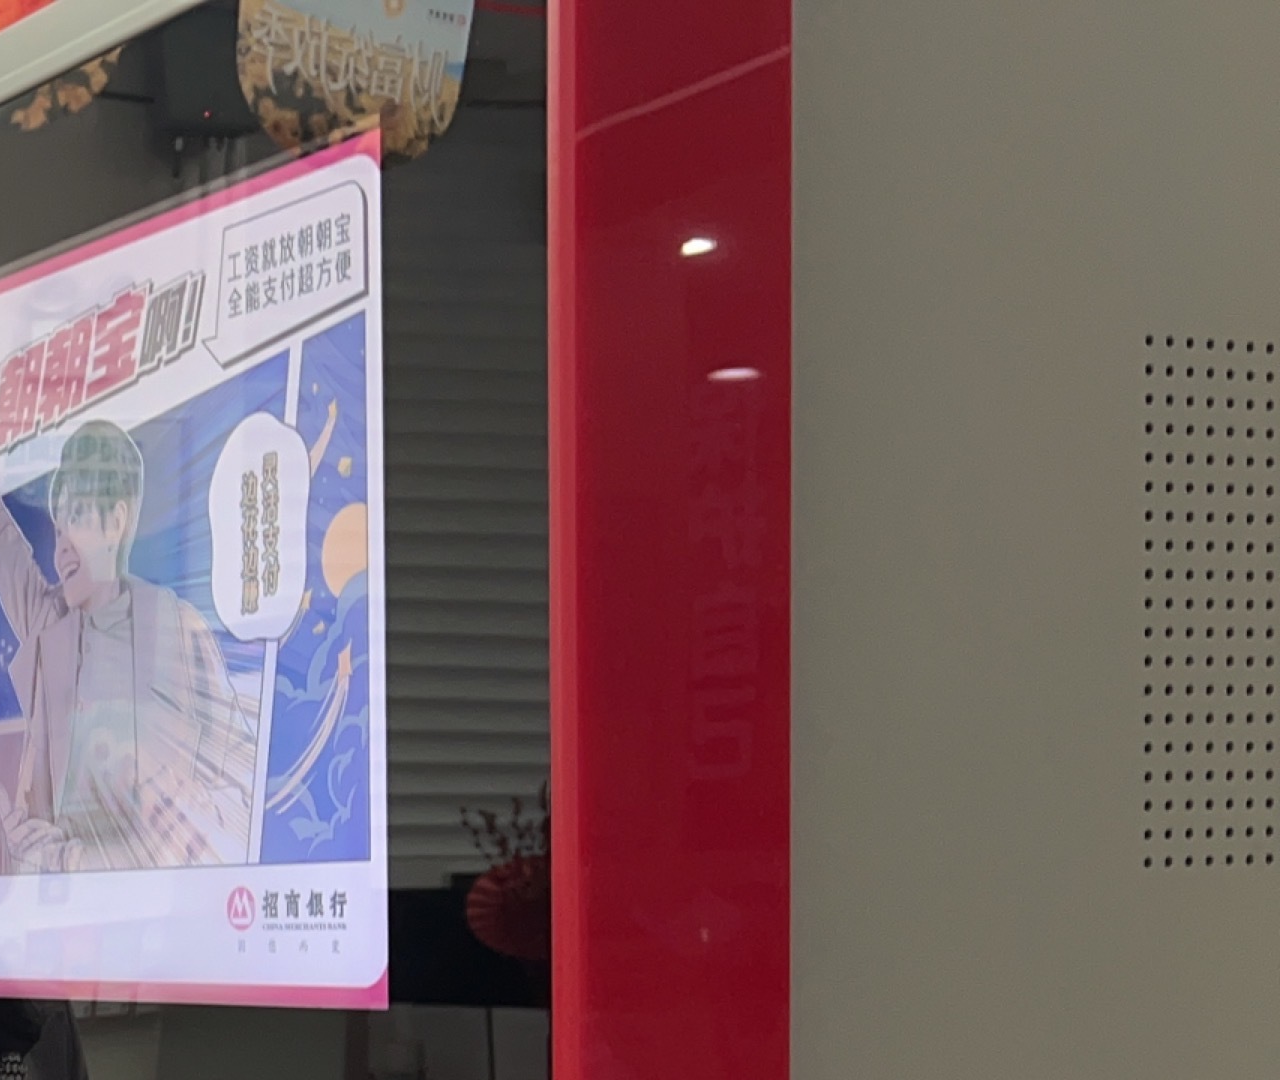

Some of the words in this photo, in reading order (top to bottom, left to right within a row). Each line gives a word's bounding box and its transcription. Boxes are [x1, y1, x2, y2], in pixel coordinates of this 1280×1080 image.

[227, 212, 351, 283] 工资就放朝朝宝
[228, 248, 352, 319] 全能支付超方便
[262, 888, 348, 918] 招商银行
